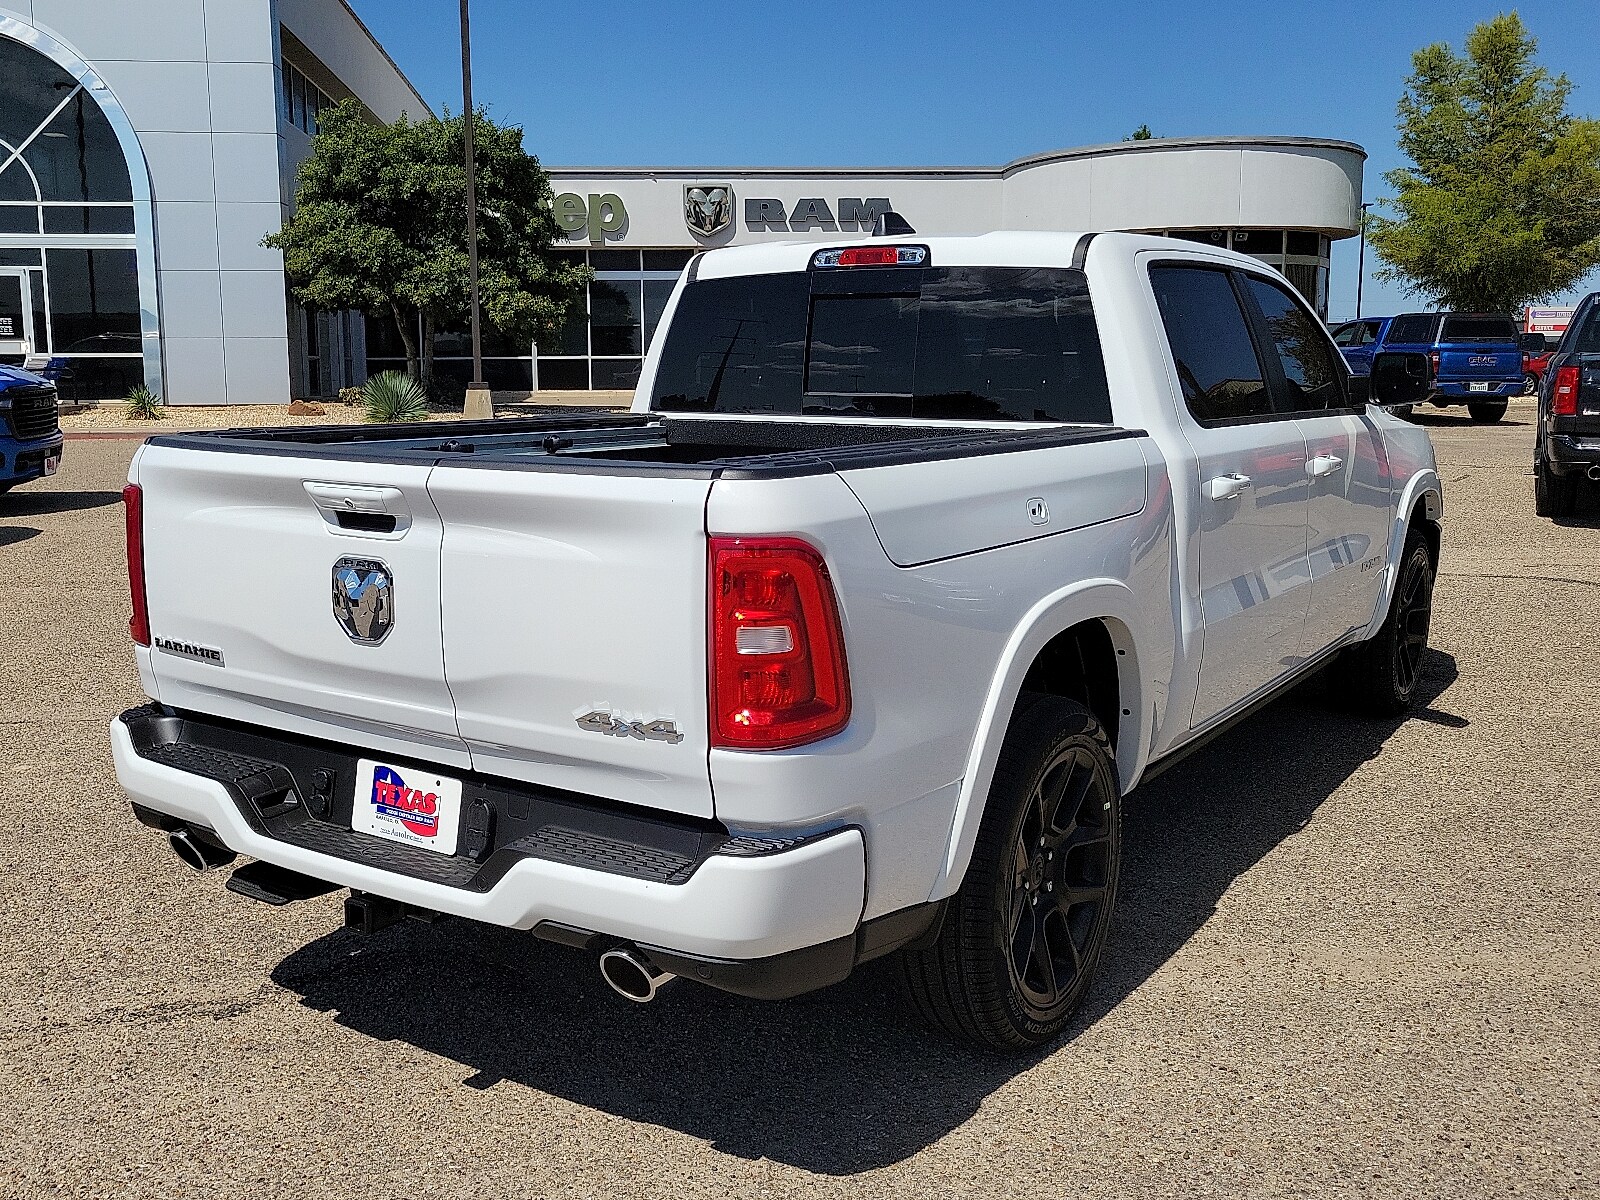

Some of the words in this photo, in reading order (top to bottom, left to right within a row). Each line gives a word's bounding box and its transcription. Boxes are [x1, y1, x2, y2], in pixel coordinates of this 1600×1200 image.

[552, 193, 625, 241] ep
[745, 198, 891, 223] RAM
[1468, 356, 1497, 364] GMC
[154, 636, 221, 660] LARAMIE
[375, 780, 437, 815] TEXAS
